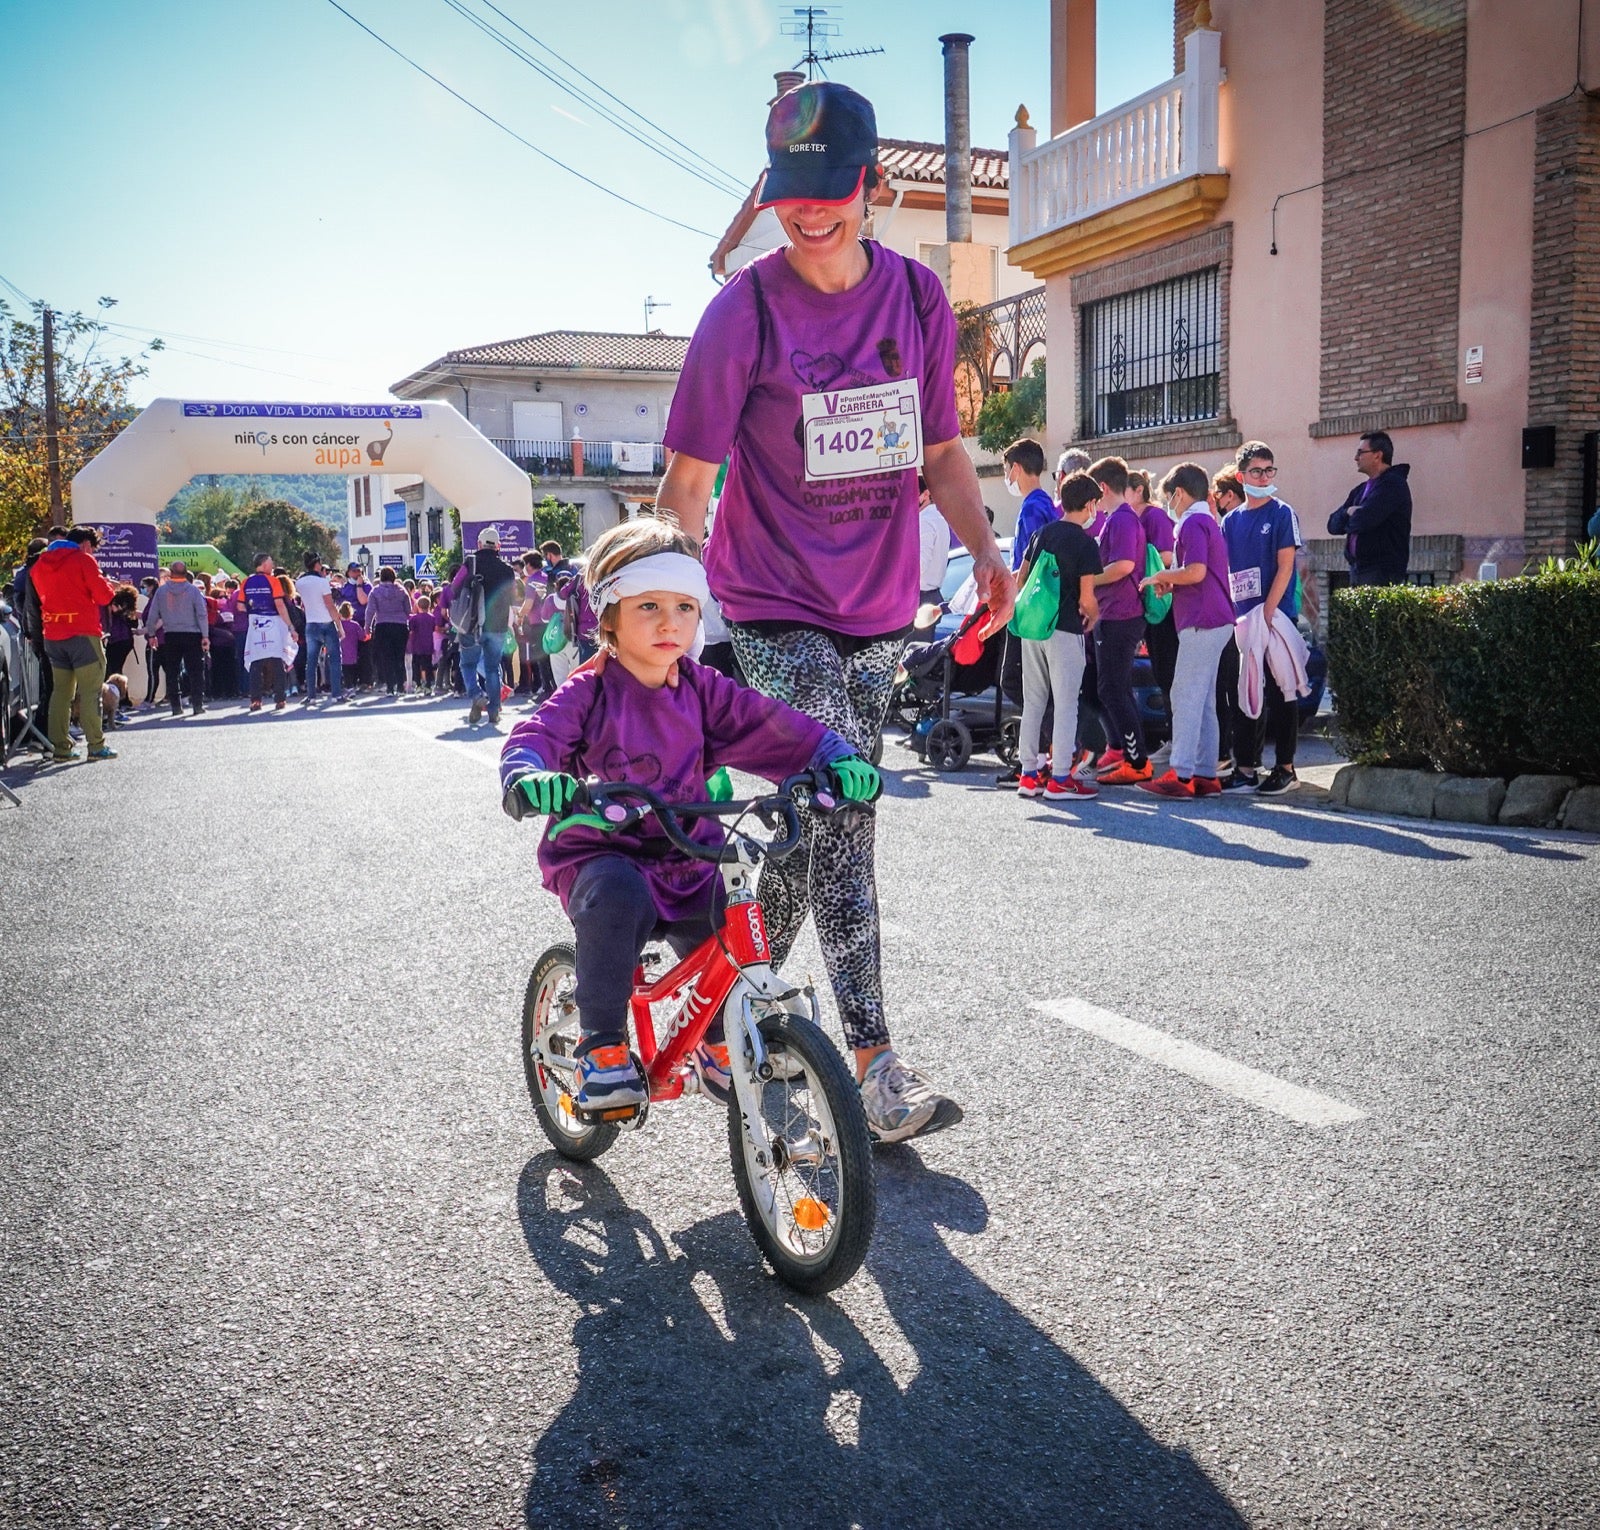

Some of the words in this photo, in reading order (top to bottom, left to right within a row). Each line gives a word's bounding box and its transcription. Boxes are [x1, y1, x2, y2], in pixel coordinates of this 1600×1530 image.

[264, 404, 295, 416] VIDA
[823, 393, 839, 415] V
[840, 400, 884, 414] CARRERA
[282, 434, 308, 445] con
[312, 432, 360, 446] cáncer
[813, 427, 875, 456] 1402
[314, 446, 361, 468] aupa
[158, 549, 199, 558] utación
